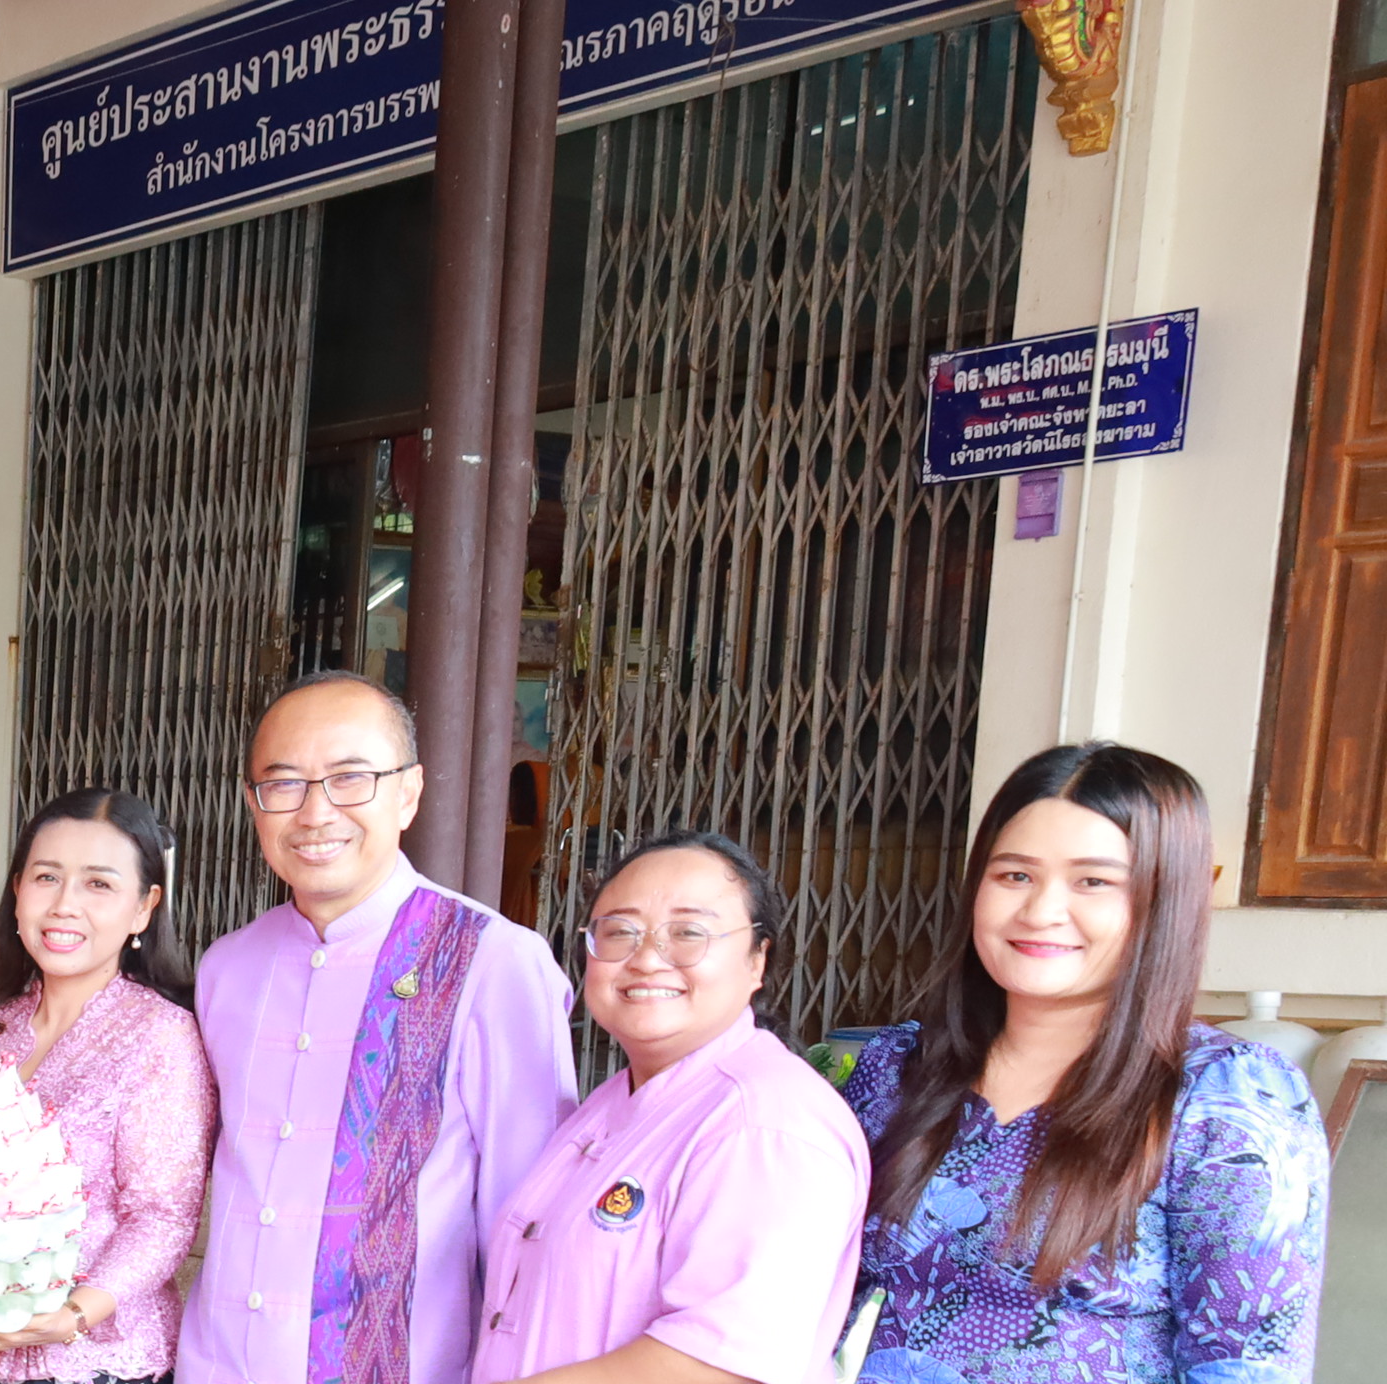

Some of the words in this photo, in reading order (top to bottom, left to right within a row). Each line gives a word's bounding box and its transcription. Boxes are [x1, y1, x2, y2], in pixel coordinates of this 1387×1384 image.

[41, 0, 445, 180] ศูนย์ประสานงานพระธร
[954, 324, 1169, 394] ดร.พระโสภณธรมมุนี
[1107, 373, 1138, 391] Ph.D.
[963, 399, 1146, 440] รองเจ้าคณะจังหดยะลา
[950, 422, 1156, 466] เจ้าอาวาสวัดนิโรธสงฆาราม
